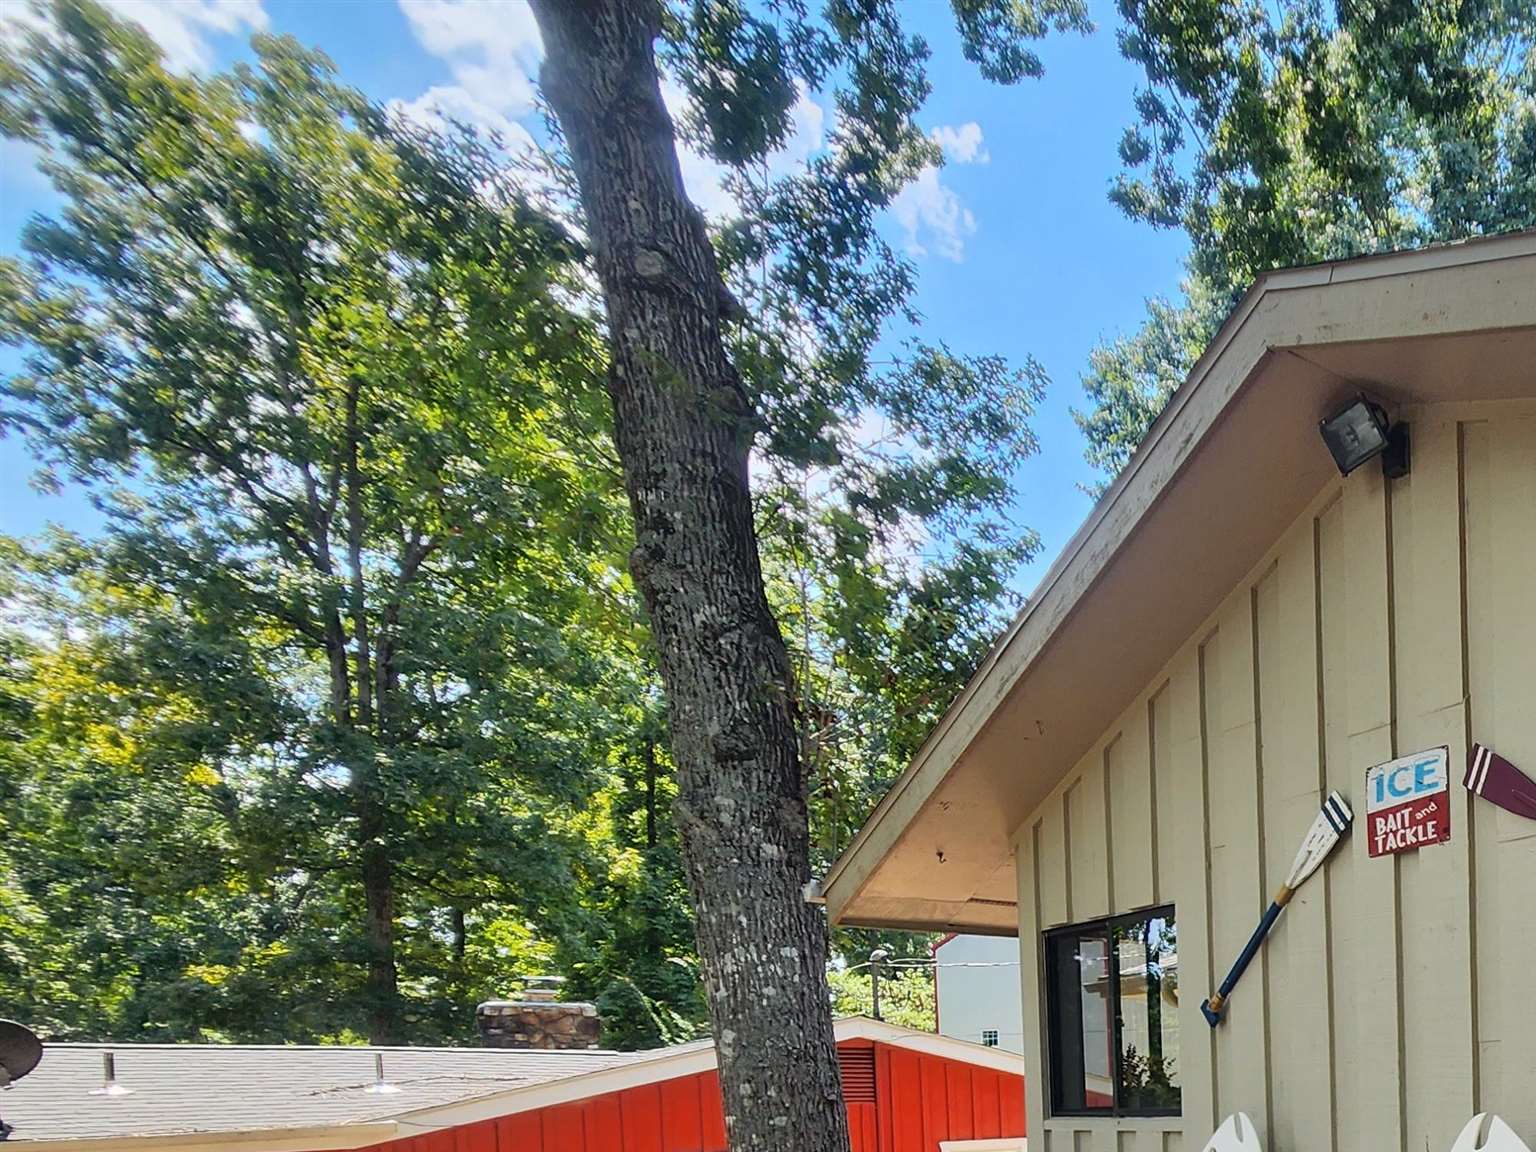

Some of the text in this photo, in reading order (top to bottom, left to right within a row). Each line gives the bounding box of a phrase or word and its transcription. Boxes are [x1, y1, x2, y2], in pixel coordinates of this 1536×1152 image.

[1375, 758, 1440, 803] ICE
[1375, 802, 1438, 836] BAIT and
[1374, 820, 1438, 854] TACKLE
